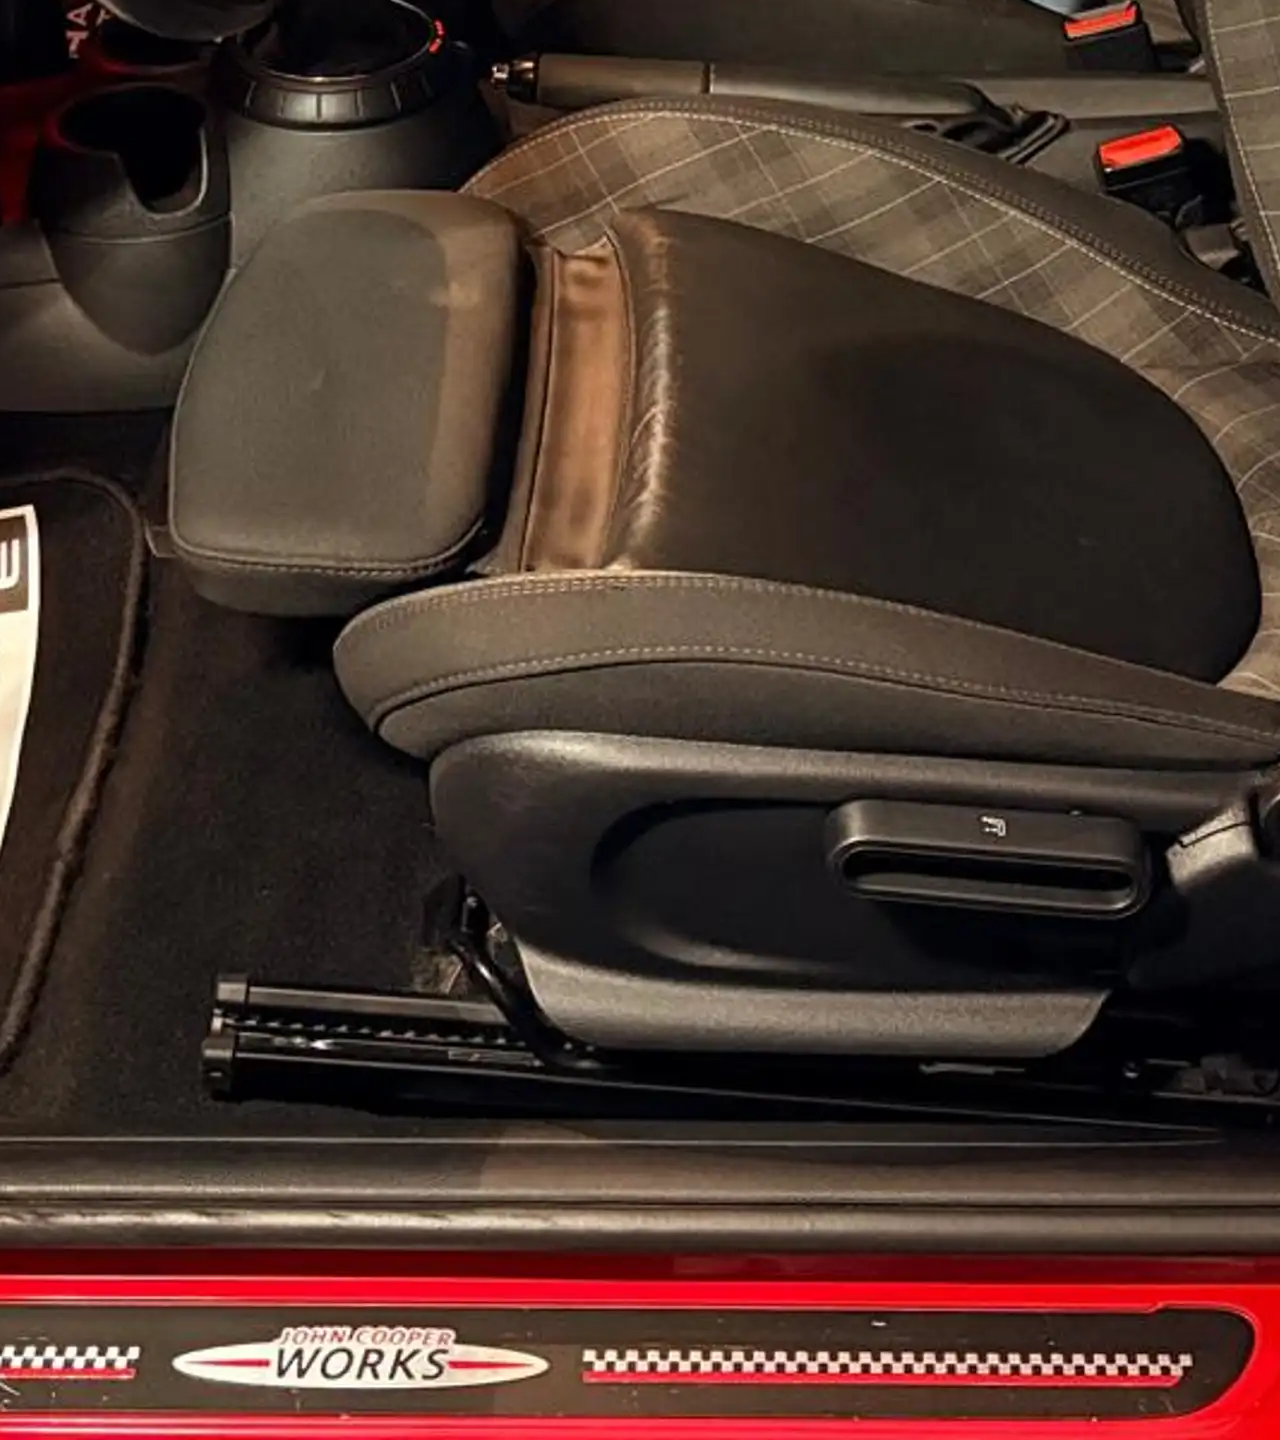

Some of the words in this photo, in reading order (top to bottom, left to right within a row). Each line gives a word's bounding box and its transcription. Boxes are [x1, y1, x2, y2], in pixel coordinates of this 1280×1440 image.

[280, 1329, 346, 1346] JOHN
[356, 1329, 453, 1346] COOPER
[276, 1347, 450, 1381] WORKS
